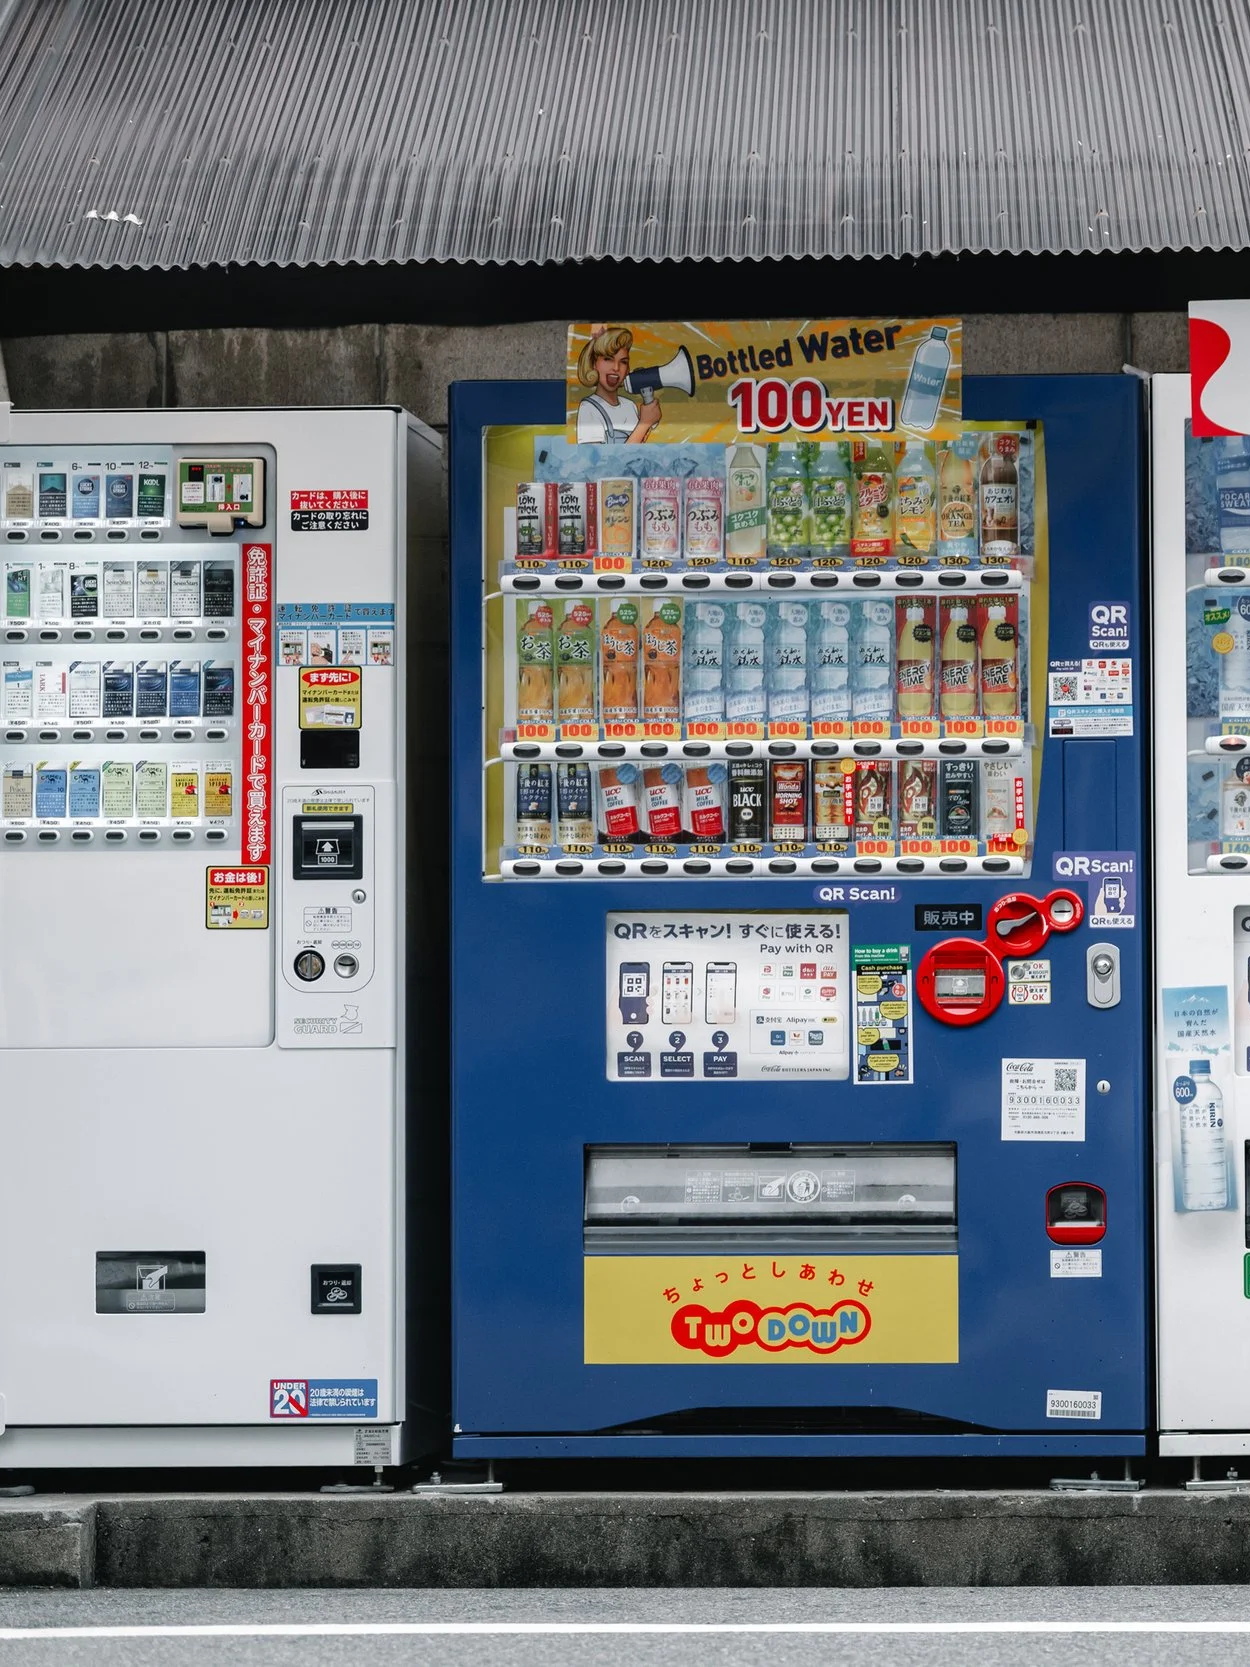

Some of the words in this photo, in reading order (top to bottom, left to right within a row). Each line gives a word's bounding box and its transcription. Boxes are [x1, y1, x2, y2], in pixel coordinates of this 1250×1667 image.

[697, 339, 793, 380] Bottled
[798, 325, 902, 362] Water
[913, 372, 941, 388] Water
[292, 491, 366, 499] カードは、購入後に
[985, 495, 1015, 503] カフェオレ
[300, 501, 358, 509] 抜いてください
[1220, 500, 1250, 508] SWEAT
[293, 512, 367, 520] カードの取り忘れに
[301, 521, 359, 530] ご注意ください
[948, 520, 966, 528] TEA
[1091, 606, 1127, 624] QR
[1092, 626, 1127, 636] Scan!
[521, 636, 551, 659] お茶
[558, 636, 589, 659] お茶
[310, 672, 351, 682] まず先に!
[899, 664, 930, 680] ENERGY
[942, 664, 974, 680] ENERGY
[246, 546, 268, 861] 免許証・マイナンバーカードで買えます
[945, 762, 974, 772] すっきり
[984, 762, 1012, 771] やさしい
[733, 793, 762, 807] BLACK
[1056, 857, 1090, 877] QR
[1091, 860, 1133, 873] Scan!
[214, 872, 262, 883] お金は後!
[820, 888, 843, 901] QR
[849, 887, 895, 900] Scan!
[923, 910, 975, 926] 販売中
[1091, 917, 1133, 925] QRも使える
[614, 923, 731, 939] QRをスキャン!
[739, 924, 841, 939] すぐに使える!
[760, 944, 781, 955] Pay
[784, 944, 813, 953] with
[815, 944, 833, 954] QR
[1174, 1009, 1219, 1018] 日本の自然が
[294, 1025, 337, 1034] GUARD
[1177, 1029, 1217, 1038] 国産天然水
[1009, 1096, 1080, 1105] 9300160033
[1209, 1102, 1217, 1128] KIRIN
[663, 1261, 874, 1305] ちょっとしあわせ
[684, 1312, 754, 1347] TWO
[767, 1311, 858, 1343] DOWN
[274, 1390, 306, 1414] 20
[310, 1398, 376, 1407] 法律で禁じられています
[1051, 1400, 1096, 1409] 9300160033
